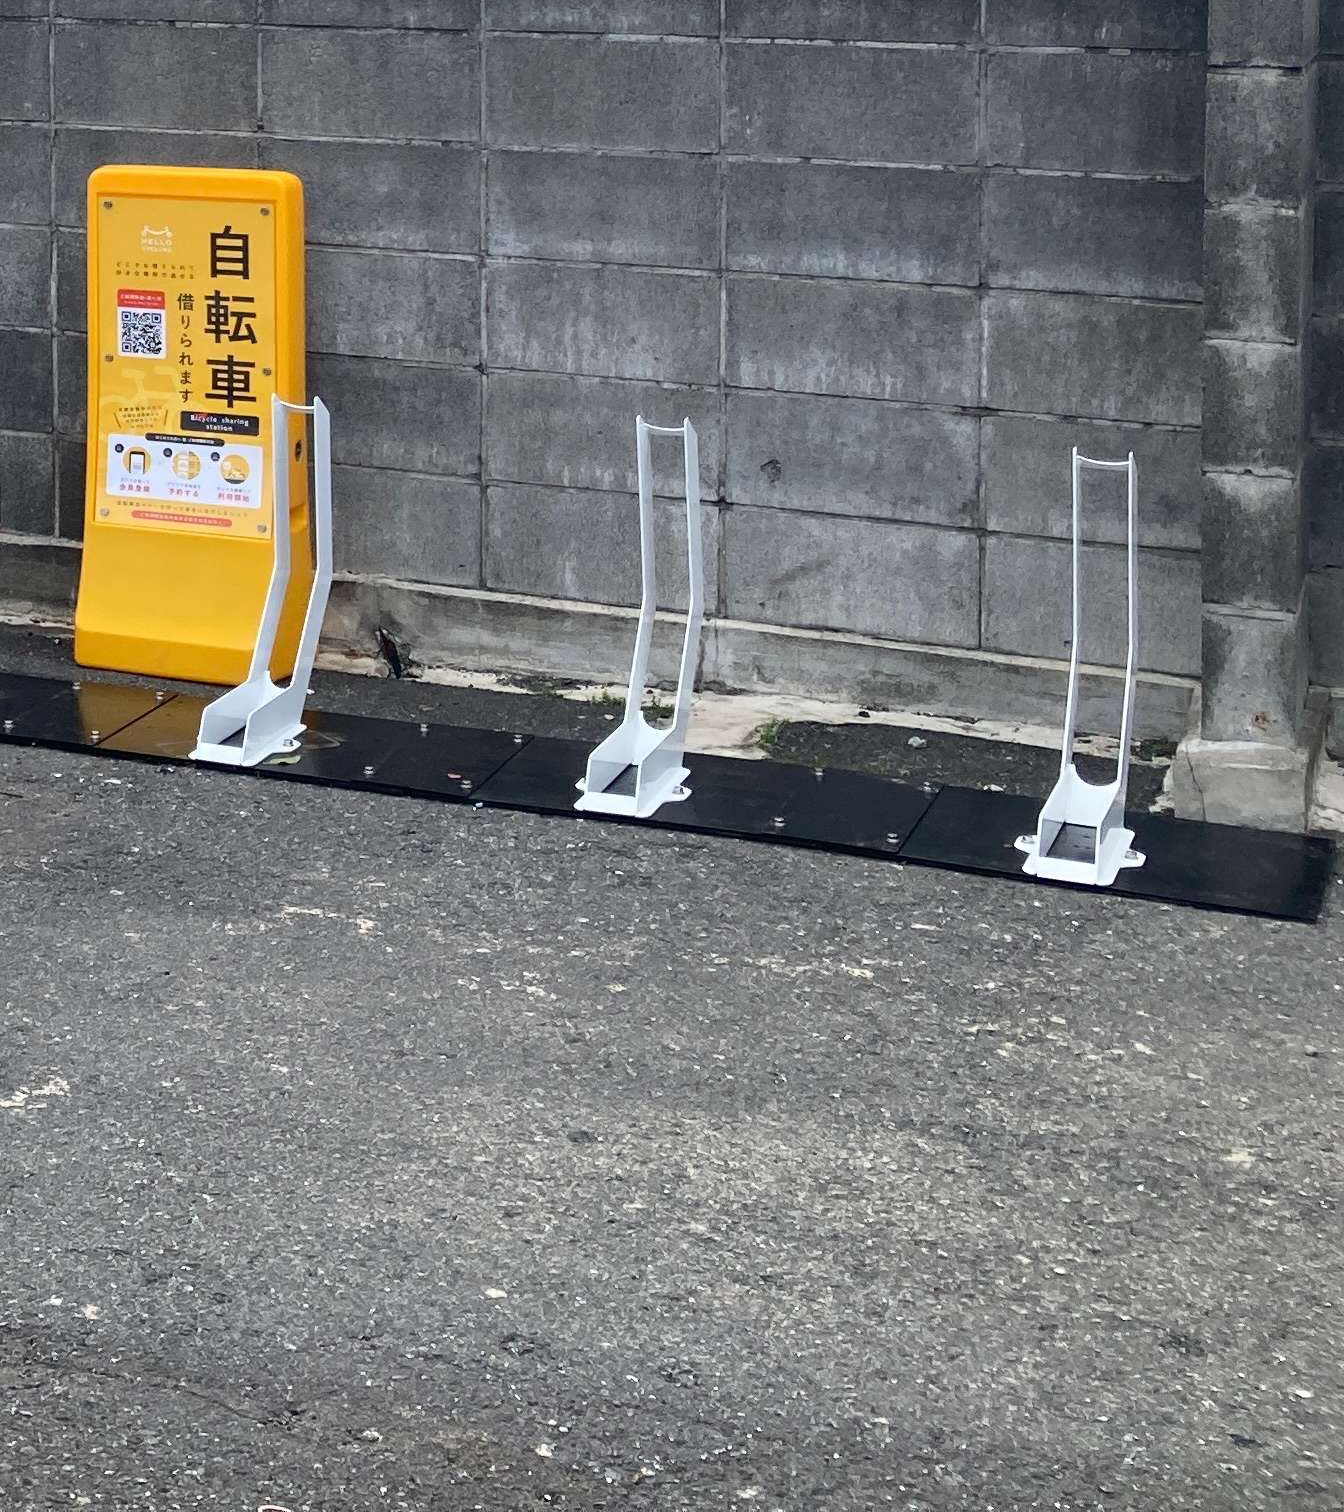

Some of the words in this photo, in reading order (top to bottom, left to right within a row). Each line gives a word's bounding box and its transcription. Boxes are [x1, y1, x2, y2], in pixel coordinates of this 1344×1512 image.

[204, 225, 258, 409] 自転車
[177, 293, 195, 403] 借りられます
[190, 414, 217, 424] Bicycle
[221, 417, 250, 427] sharing
[206, 424, 233, 432] station
